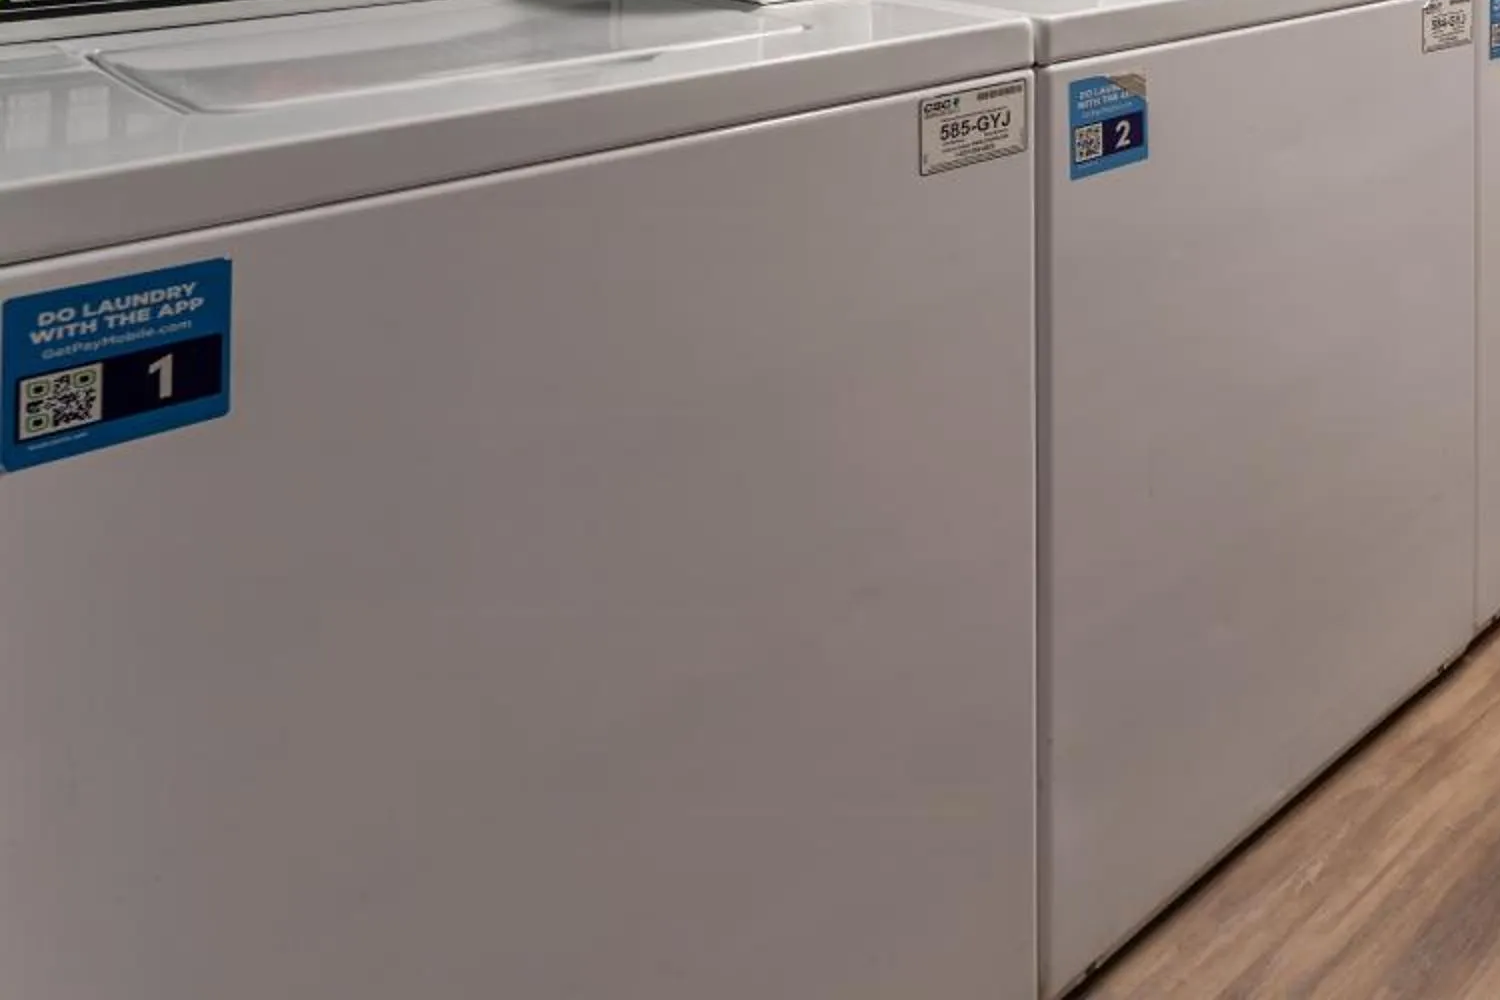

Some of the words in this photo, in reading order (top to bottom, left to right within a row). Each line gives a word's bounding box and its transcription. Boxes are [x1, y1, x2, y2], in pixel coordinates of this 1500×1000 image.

[940, 109, 1011, 141] 585-GYJ
[1115, 120, 1131, 149] 2
[29, 319, 98, 345] WITH
[104, 307, 150, 329] THE
[156, 296, 205, 319] APP
[37, 307, 76, 327] DO
[83, 281, 198, 318] LAUNDRY
[41, 319, 193, 360] GetPayMobile.com
[147, 352, 174, 400] 1
